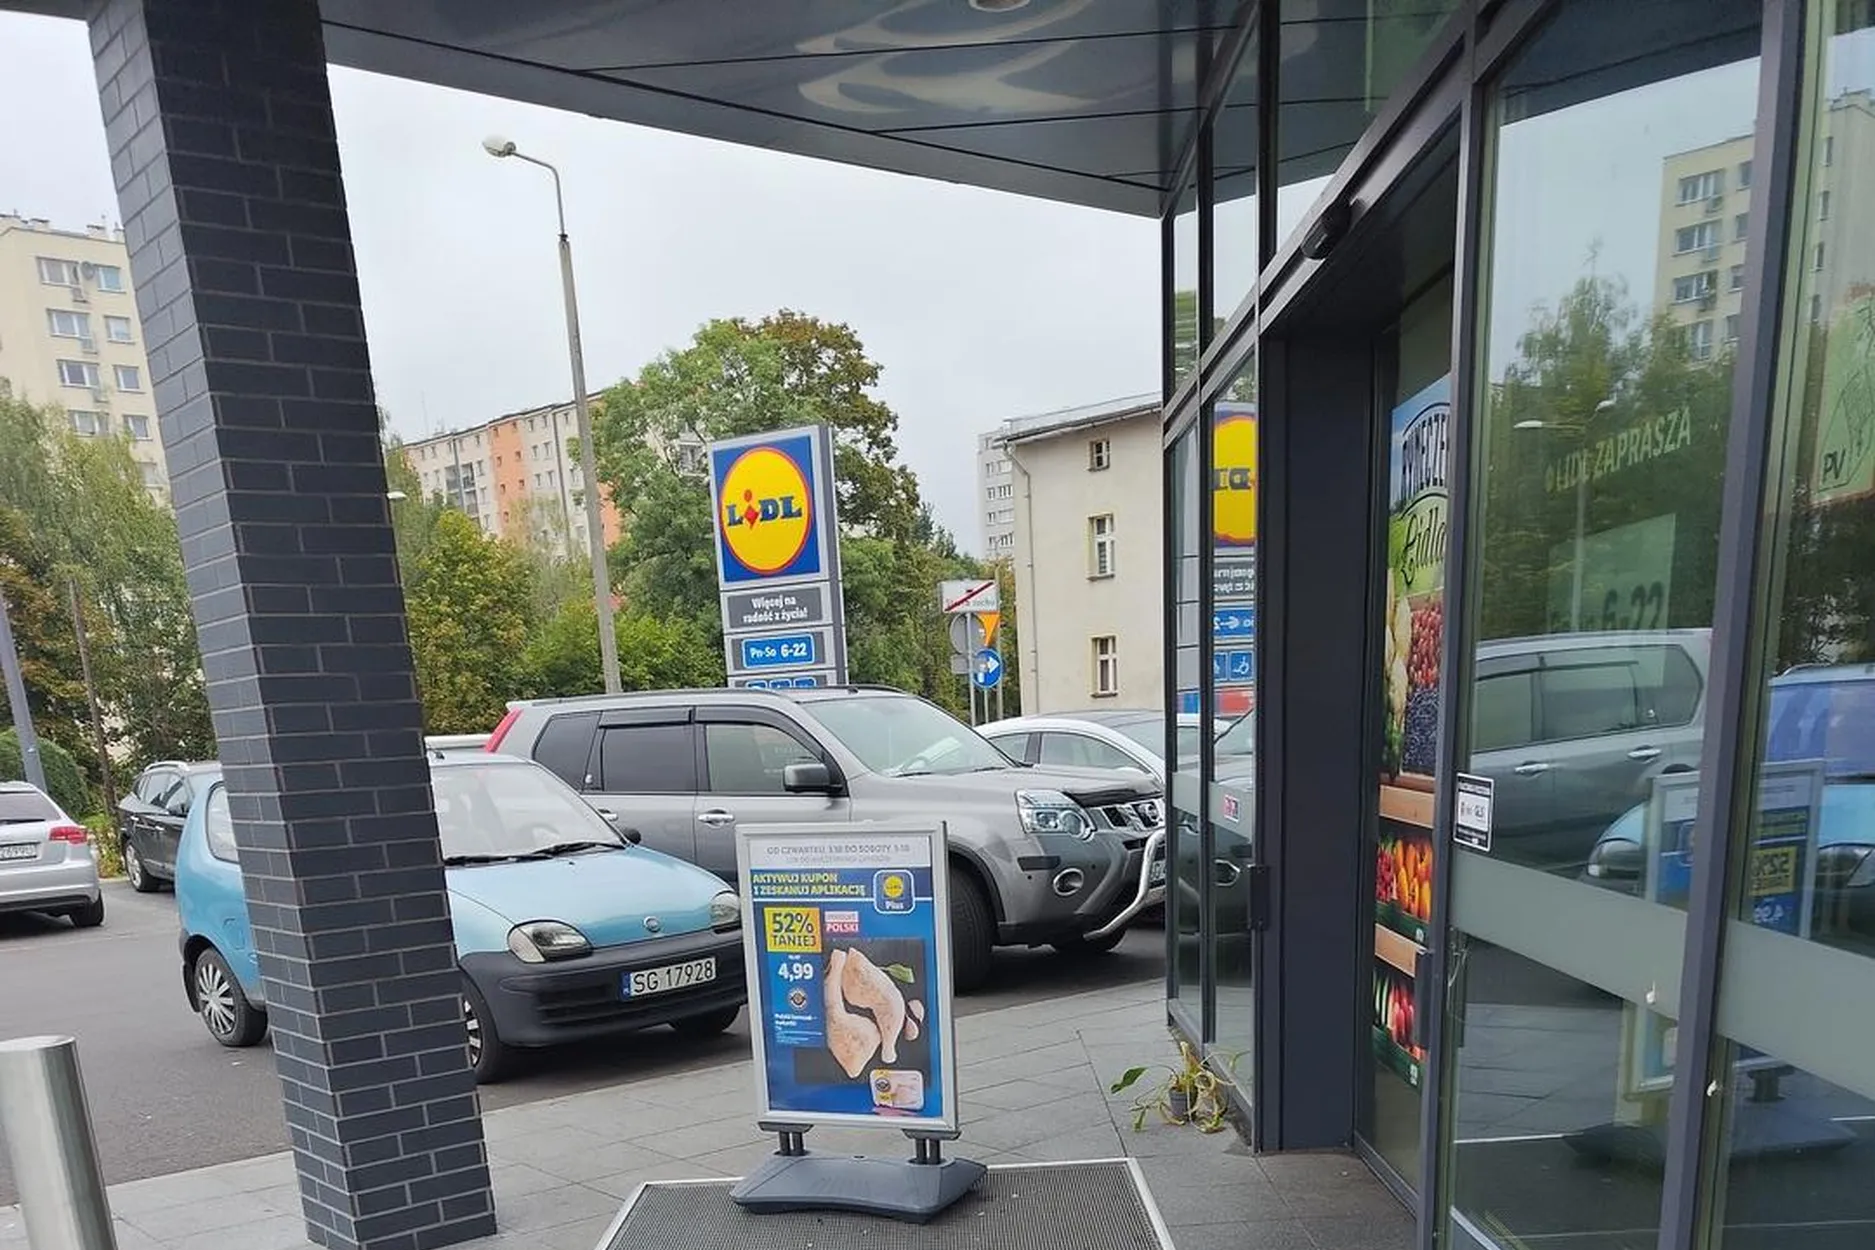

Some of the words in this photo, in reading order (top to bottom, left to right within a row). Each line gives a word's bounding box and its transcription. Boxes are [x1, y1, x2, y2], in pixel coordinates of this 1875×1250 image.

[1593, 405, 1692, 481] ZAPRASZA
[780, 642, 808, 658] 6-22
[800, 872, 838, 883] KUPON
[772, 912, 814, 934] 52%
[826, 923, 859, 933] POLSKI
[773, 935, 816, 947] TANIEJ
[633, 971, 659, 994] SG
[665, 960, 713, 987] 17928
[778, 962, 814, 982] 4,99
